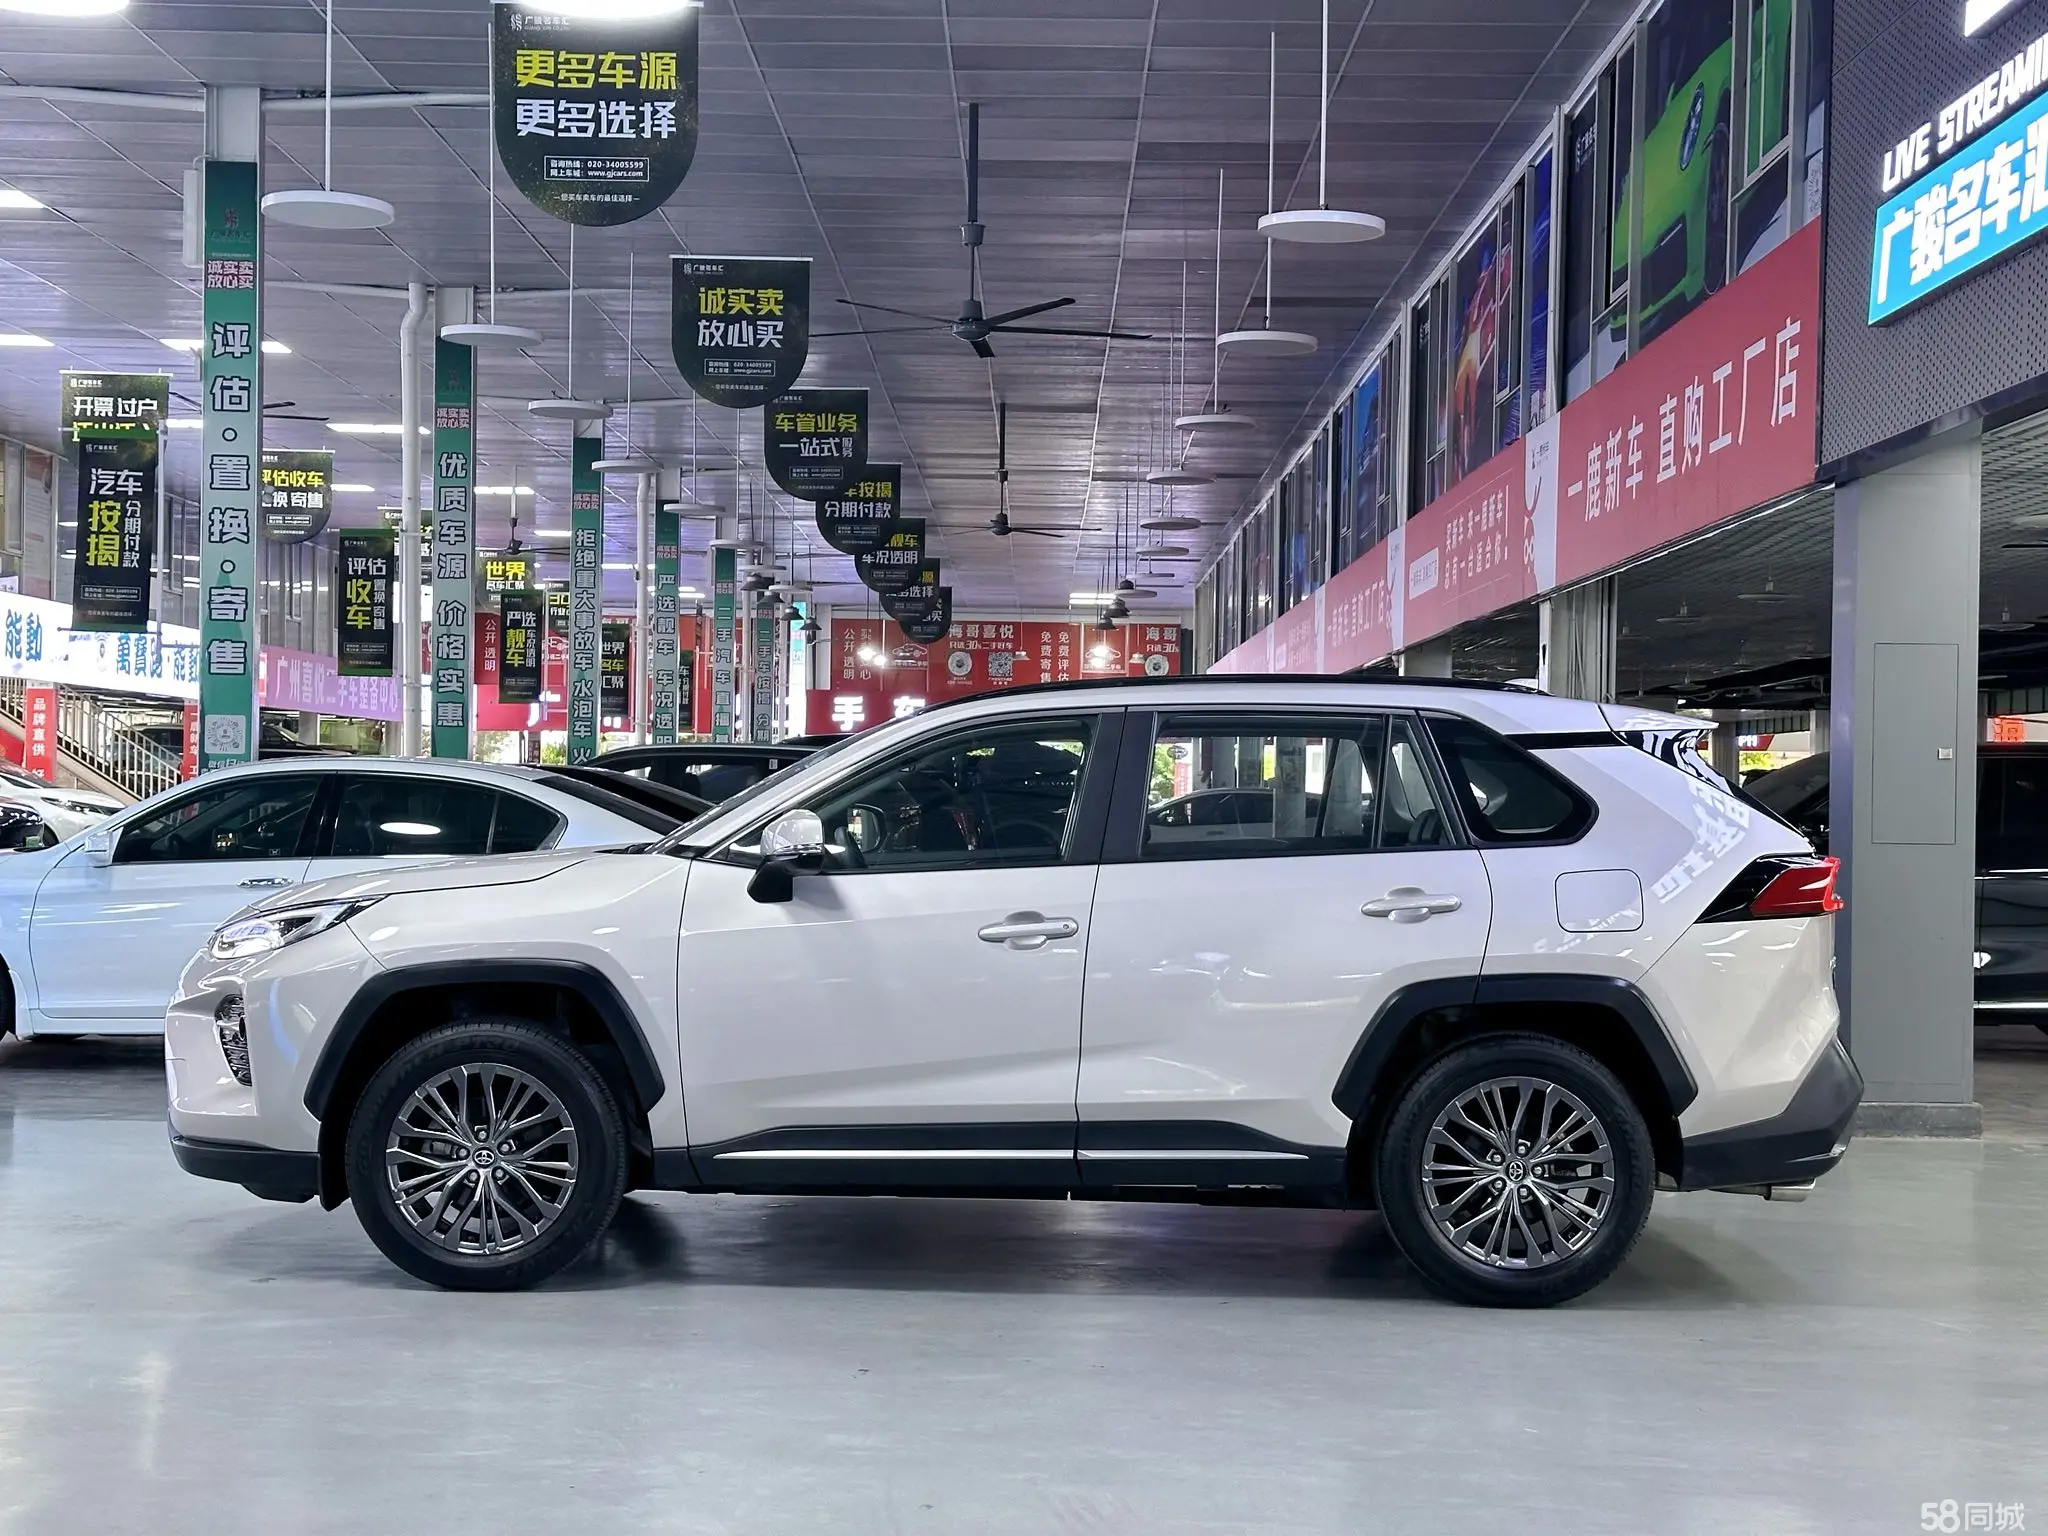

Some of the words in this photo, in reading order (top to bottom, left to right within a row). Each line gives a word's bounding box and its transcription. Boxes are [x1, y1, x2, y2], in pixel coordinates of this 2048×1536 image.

[516, 49, 678, 90] 更多车源
[516, 98, 678, 139] 更多选择
[587, 161, 644, 169] 020-34005599
[587, 169, 643, 178] www.gjcars.com
[1882, 121, 1932, 193] LIVE
[1877, 111, 2048, 305] 广骏名车汇
[208, 260, 254, 275] 诚实卖
[208, 274, 254, 289] 放心买
[698, 287, 784, 316] 诚实卖
[697, 319, 784, 348] 放心买
[73, 396, 158, 418] 开票过户
[775, 412, 857, 433] 车管业务
[1567, 414, 1644, 522] 一鹿新车
[1655, 316, 1801, 485] 直购工厂店
[779, 437, 840, 458] 一站式
[90, 467, 144, 496] 汽车
[437, 451, 468, 580] 优质车源
[825, 501, 892, 518] 分期付款
[86, 500, 121, 568] 按揭
[122, 500, 142, 569] 分期付款
[347, 557, 387, 576] 评估
[485, 561, 525, 581] 世界
[861, 550, 918, 565] 车况透明
[346, 578, 372, 630] 收车
[507, 611, 536, 627] 严选
[574, 528, 597, 672] 拒绝重大事故车
[656, 573, 677, 656] 严选靓车
[484, 619, 497, 672] 公开透明
[505, 628, 526, 667] 靓车
[843, 628, 855, 680] 公开透明
[1146, 626, 1178, 642] 海哥
[436, 599, 467, 729] 价格实惠
[1040, 631, 1052, 683] 免费寄售
[1058, 630, 1070, 682] 免费评估
[572, 679, 595, 739] 水泡车
